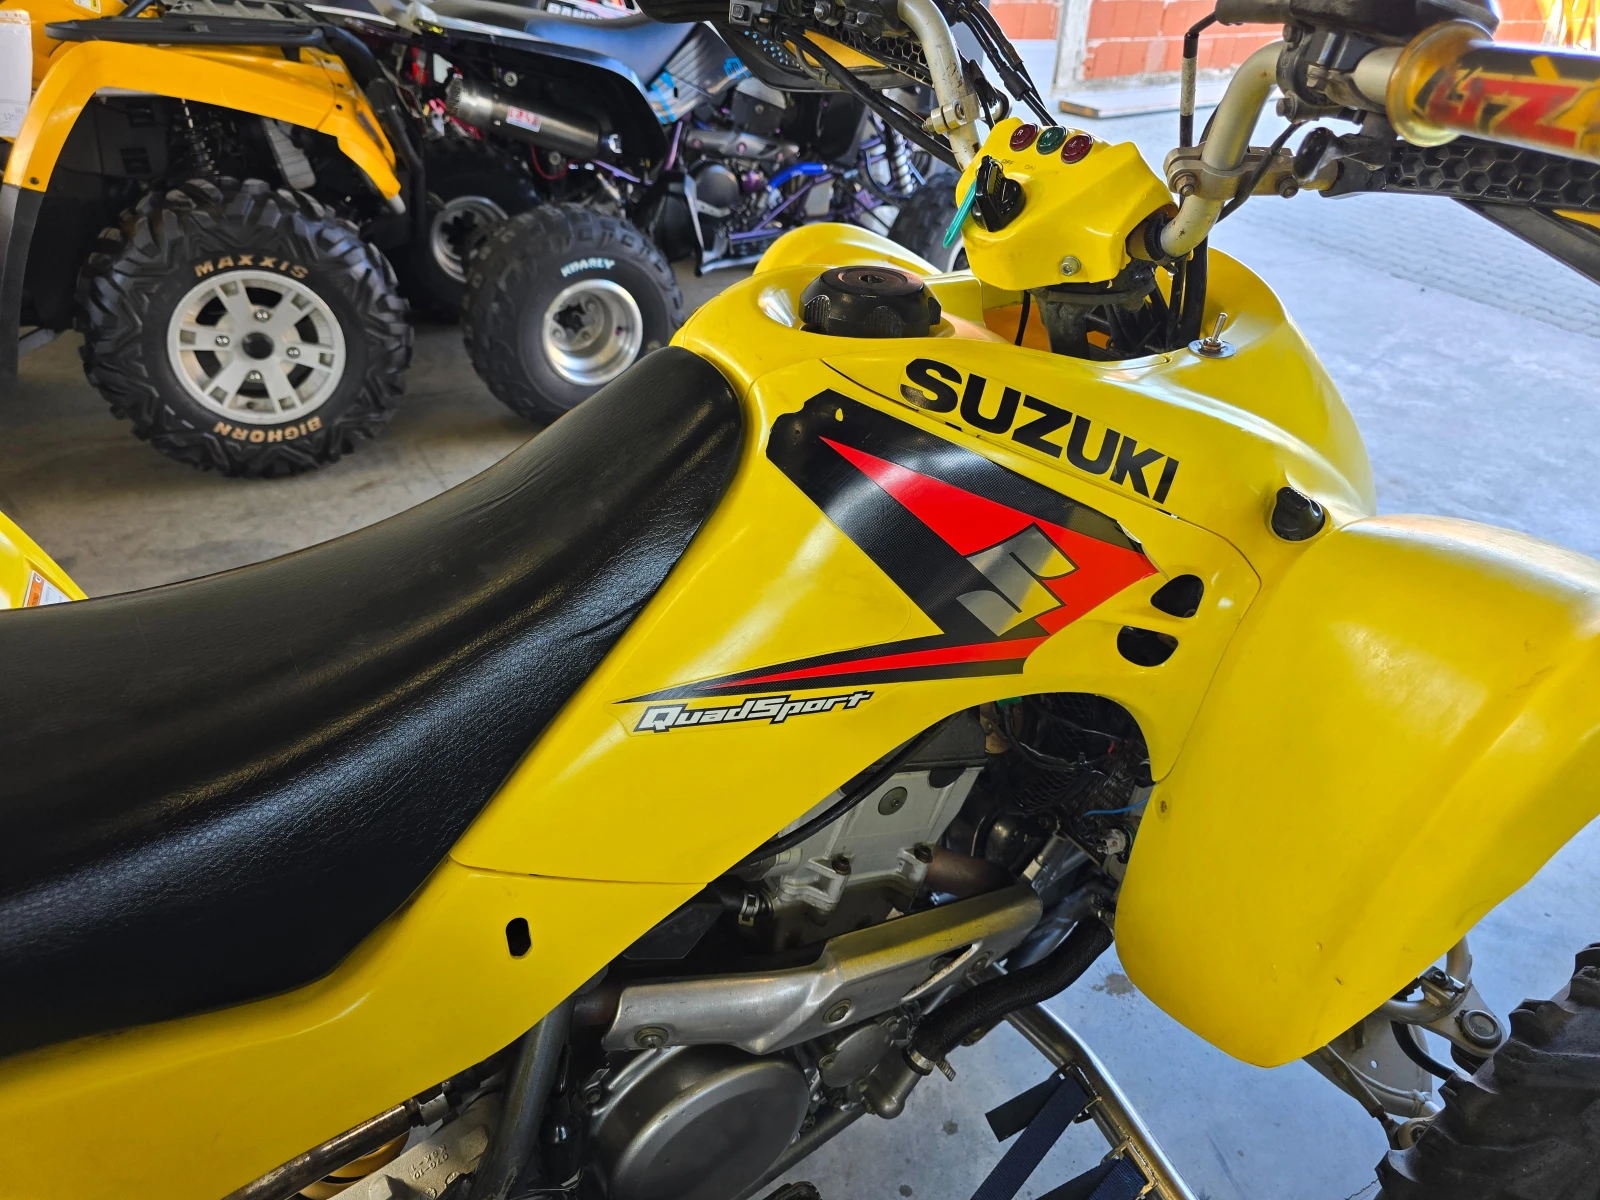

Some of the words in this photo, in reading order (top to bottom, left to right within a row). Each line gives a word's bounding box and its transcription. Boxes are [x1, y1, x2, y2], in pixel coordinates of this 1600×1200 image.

[1001, 158, 1015, 166] OFF
[194, 254, 309, 278] MAXXIS
[213, 416, 322, 442] BIGHORN
[900, 358, 1179, 504] SUZUKI
[634, 691, 874, 732] QuadSport
